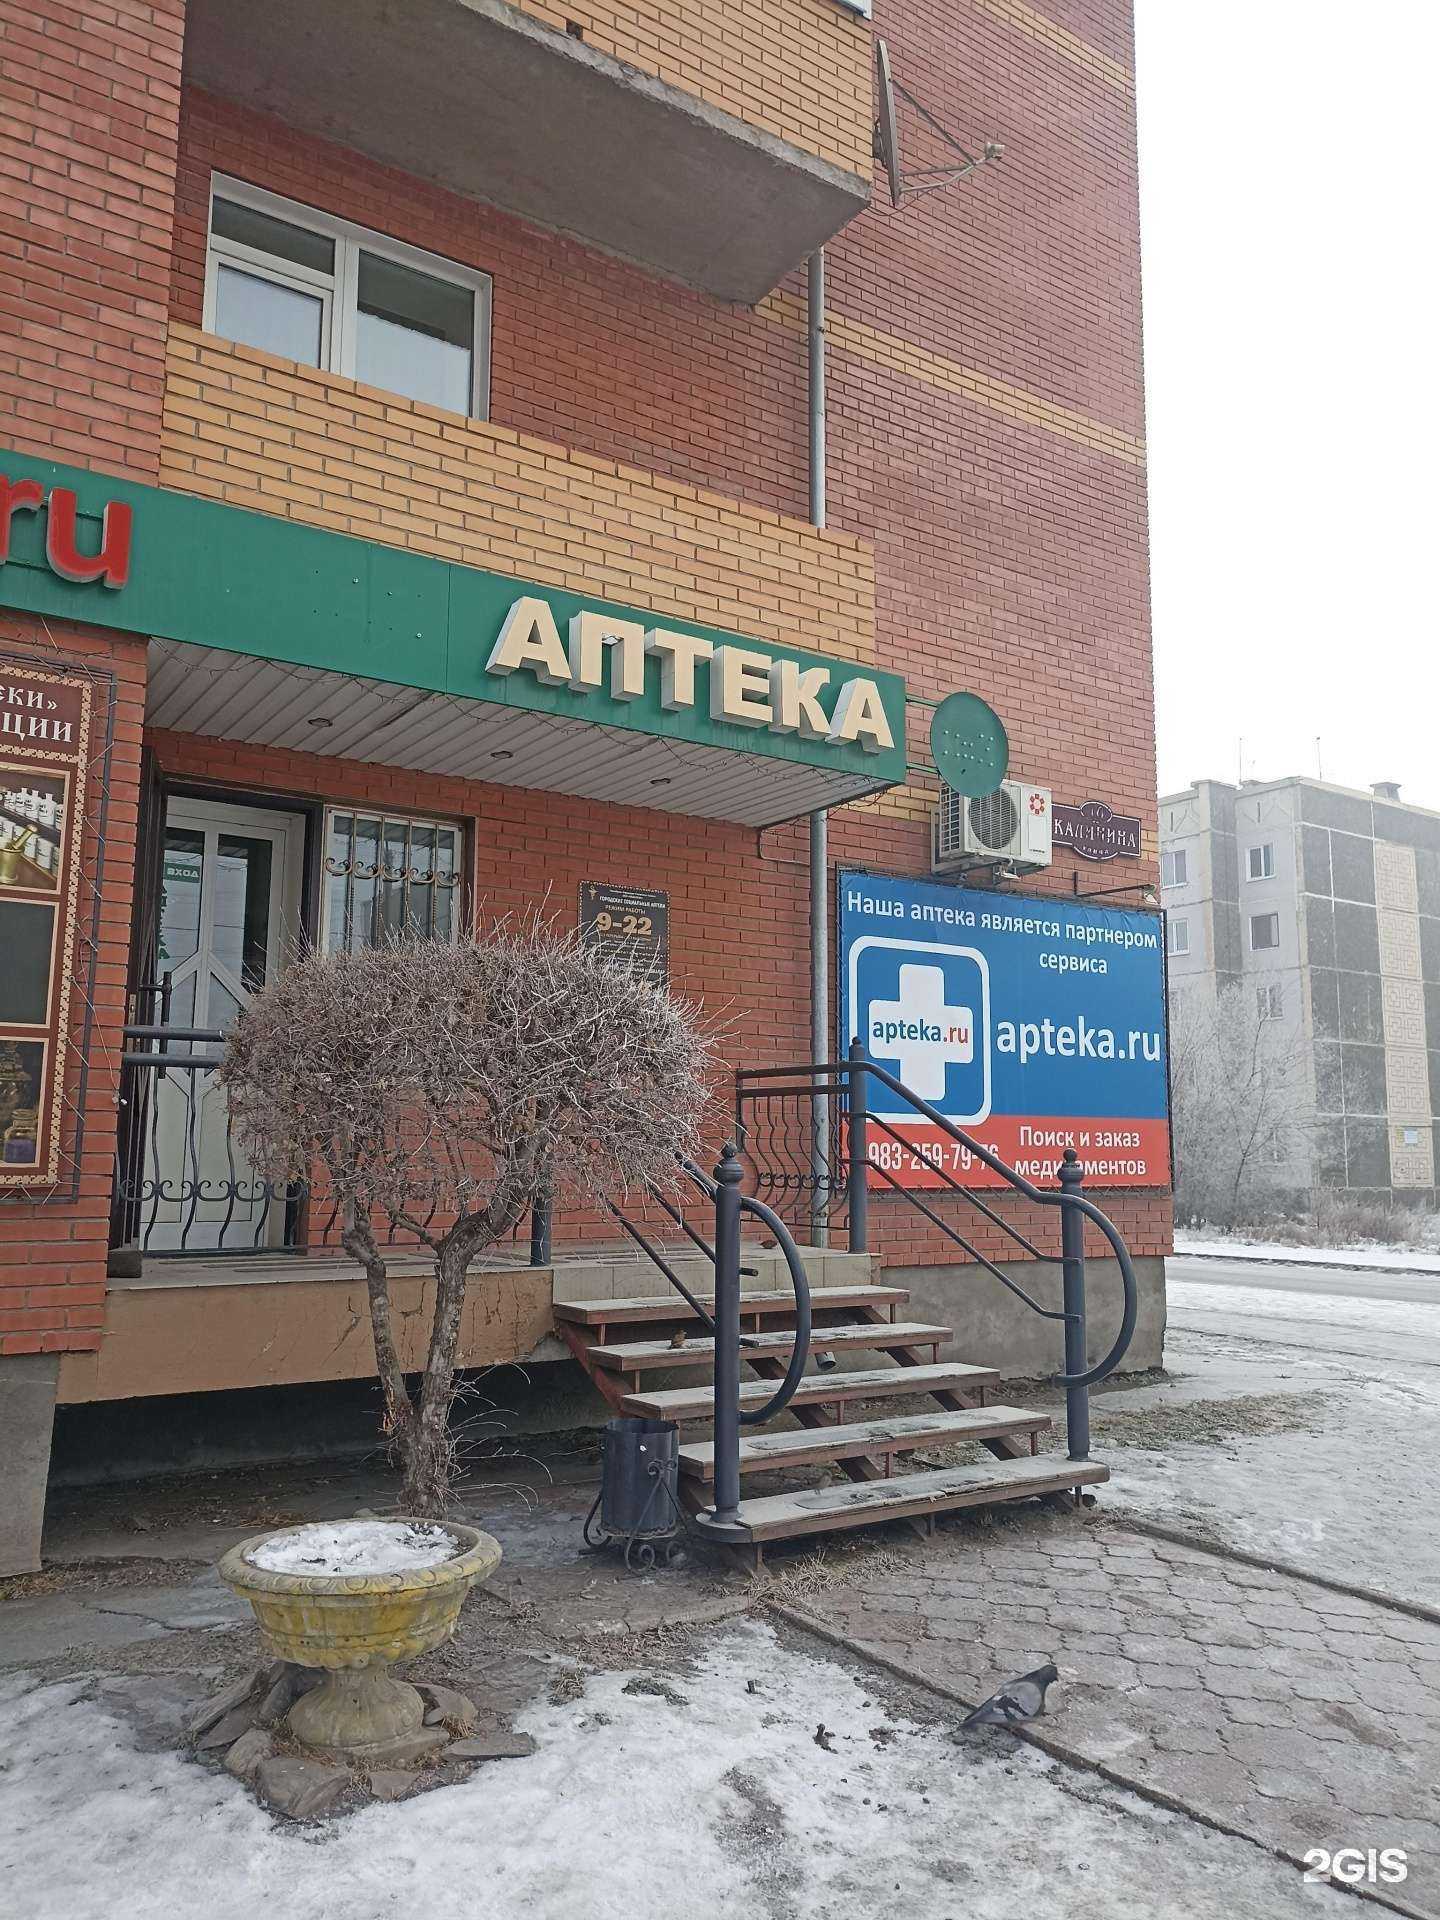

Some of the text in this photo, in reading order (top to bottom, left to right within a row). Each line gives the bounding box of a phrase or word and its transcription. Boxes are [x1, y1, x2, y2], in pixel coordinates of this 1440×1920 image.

[485, 596, 896, 754] АПТЕКА
[1054, 818, 1136, 848] КАЛИНИНА
[596, 912, 652, 935] 9-22
[847, 890, 1158, 950] Наша аптека является партнером
[1039, 952, 1108, 975] сервиса
[872, 1018, 969, 1045] apteka.ru
[996, 1015, 1162, 1064] apteka.ru
[1019, 1125, 1140, 1148] Поиск и заказ
[1014, 1159, 1147, 1180] медиаментов
